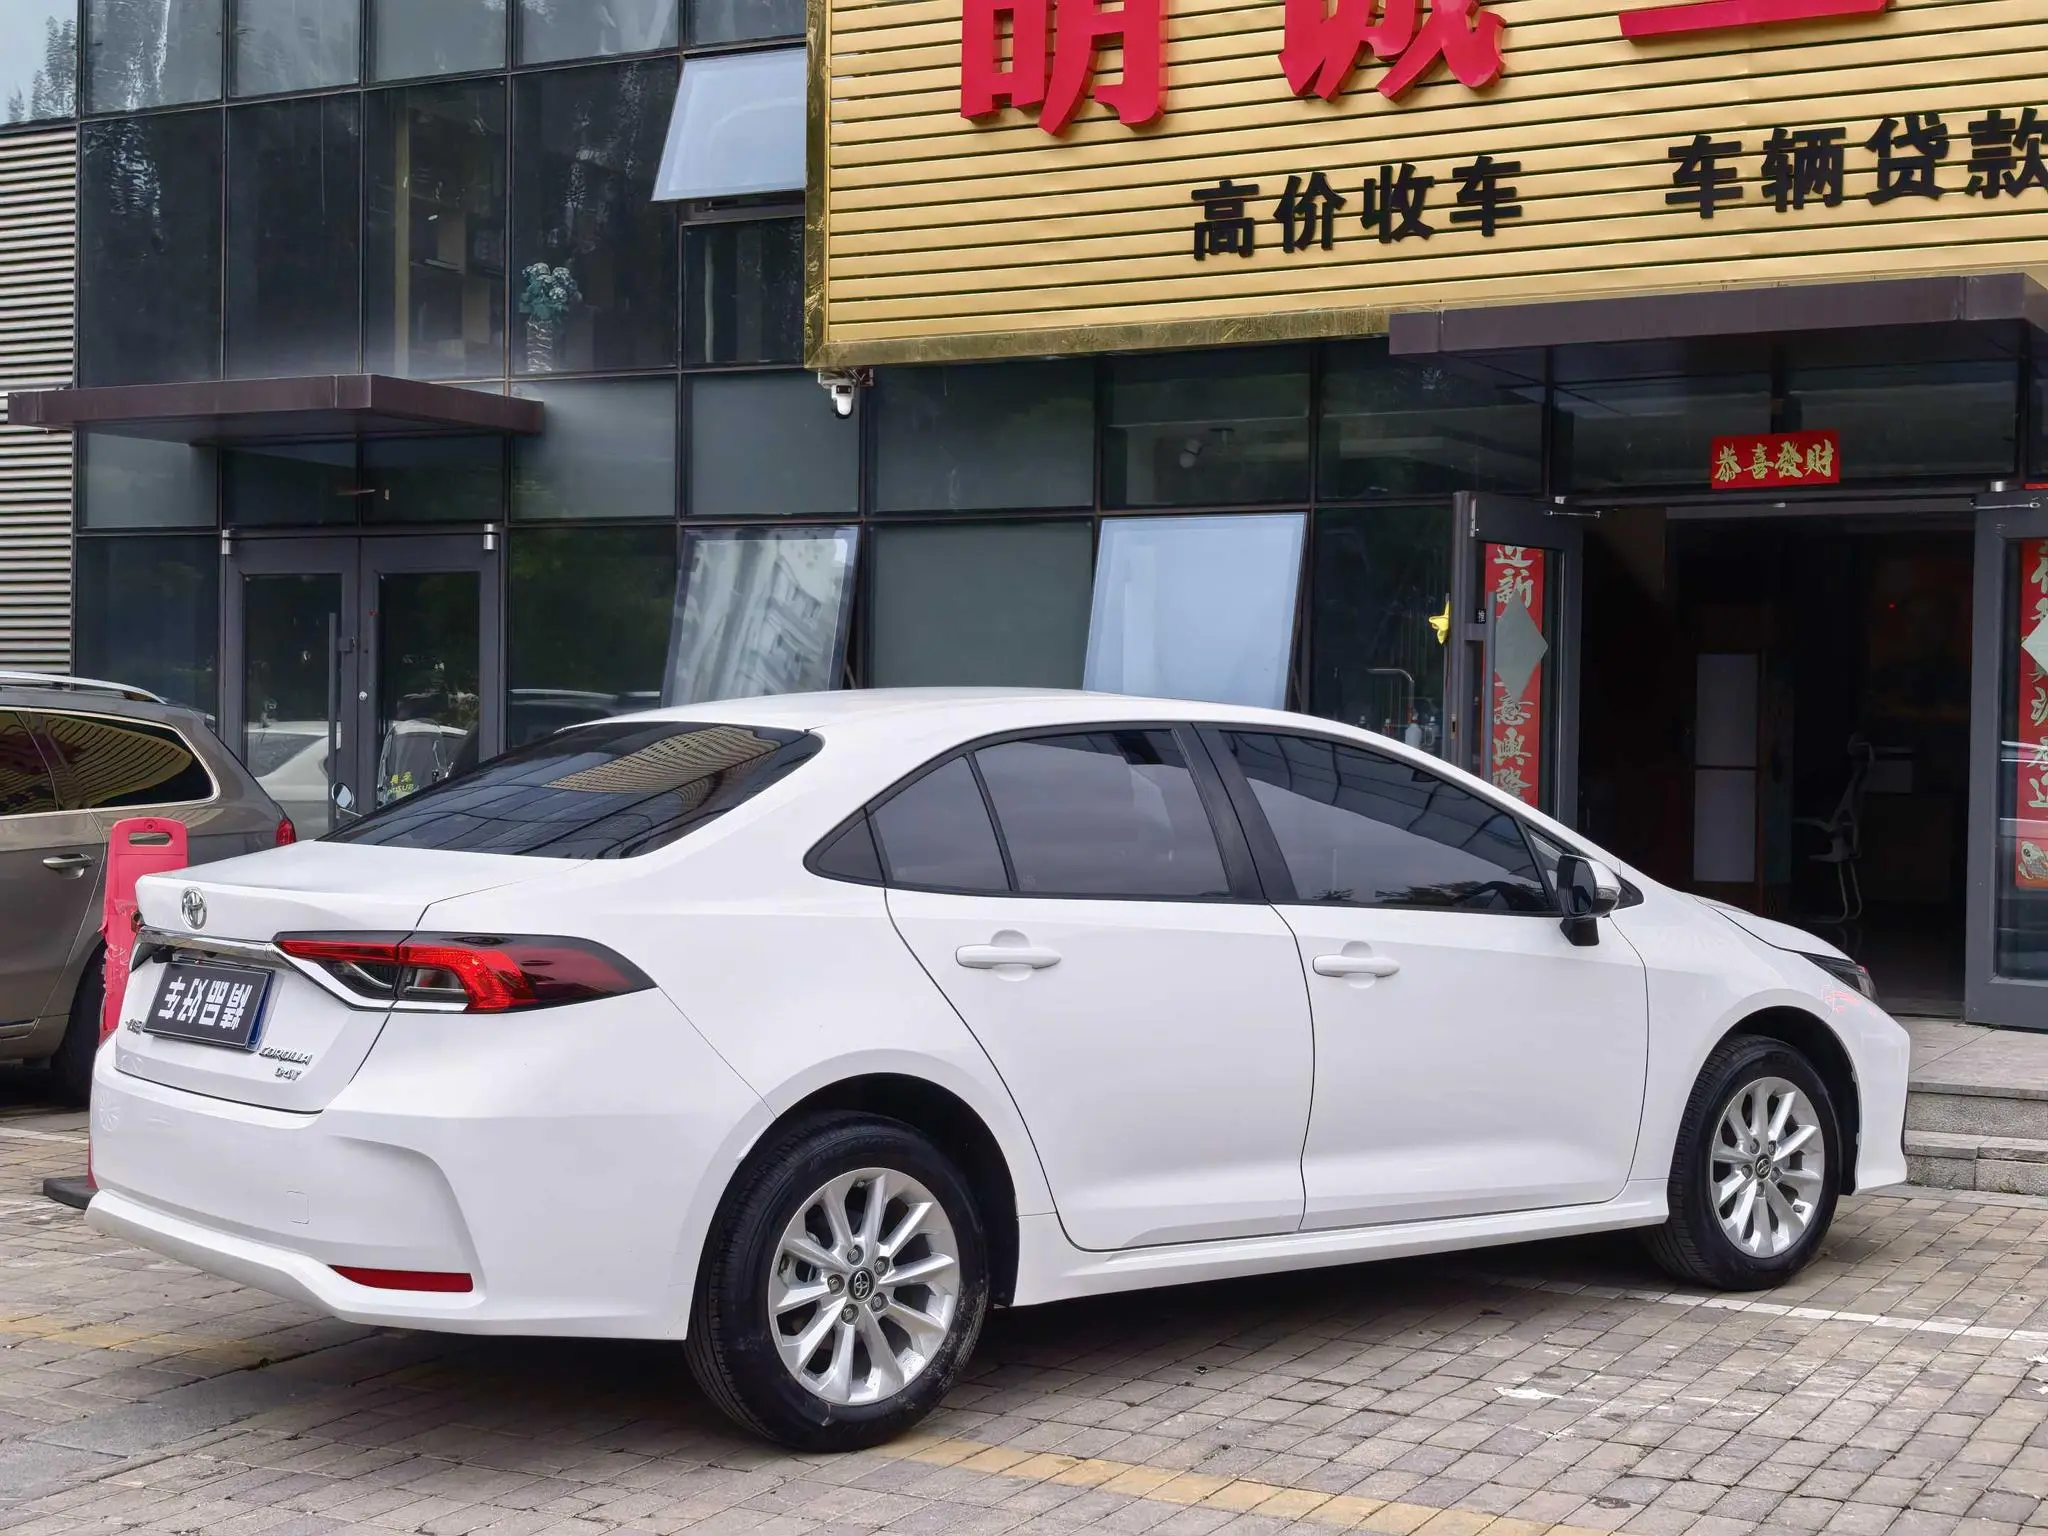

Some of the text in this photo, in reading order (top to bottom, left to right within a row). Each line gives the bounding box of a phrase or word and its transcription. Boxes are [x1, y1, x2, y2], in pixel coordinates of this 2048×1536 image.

[1191, 107, 2048, 262] 高价收车 车辆贷款
[1714, 438, 1834, 483] 恭喜發財
[158, 976, 253, 1030] 精品好车
[259, 1047, 313, 1066] COROLLA
